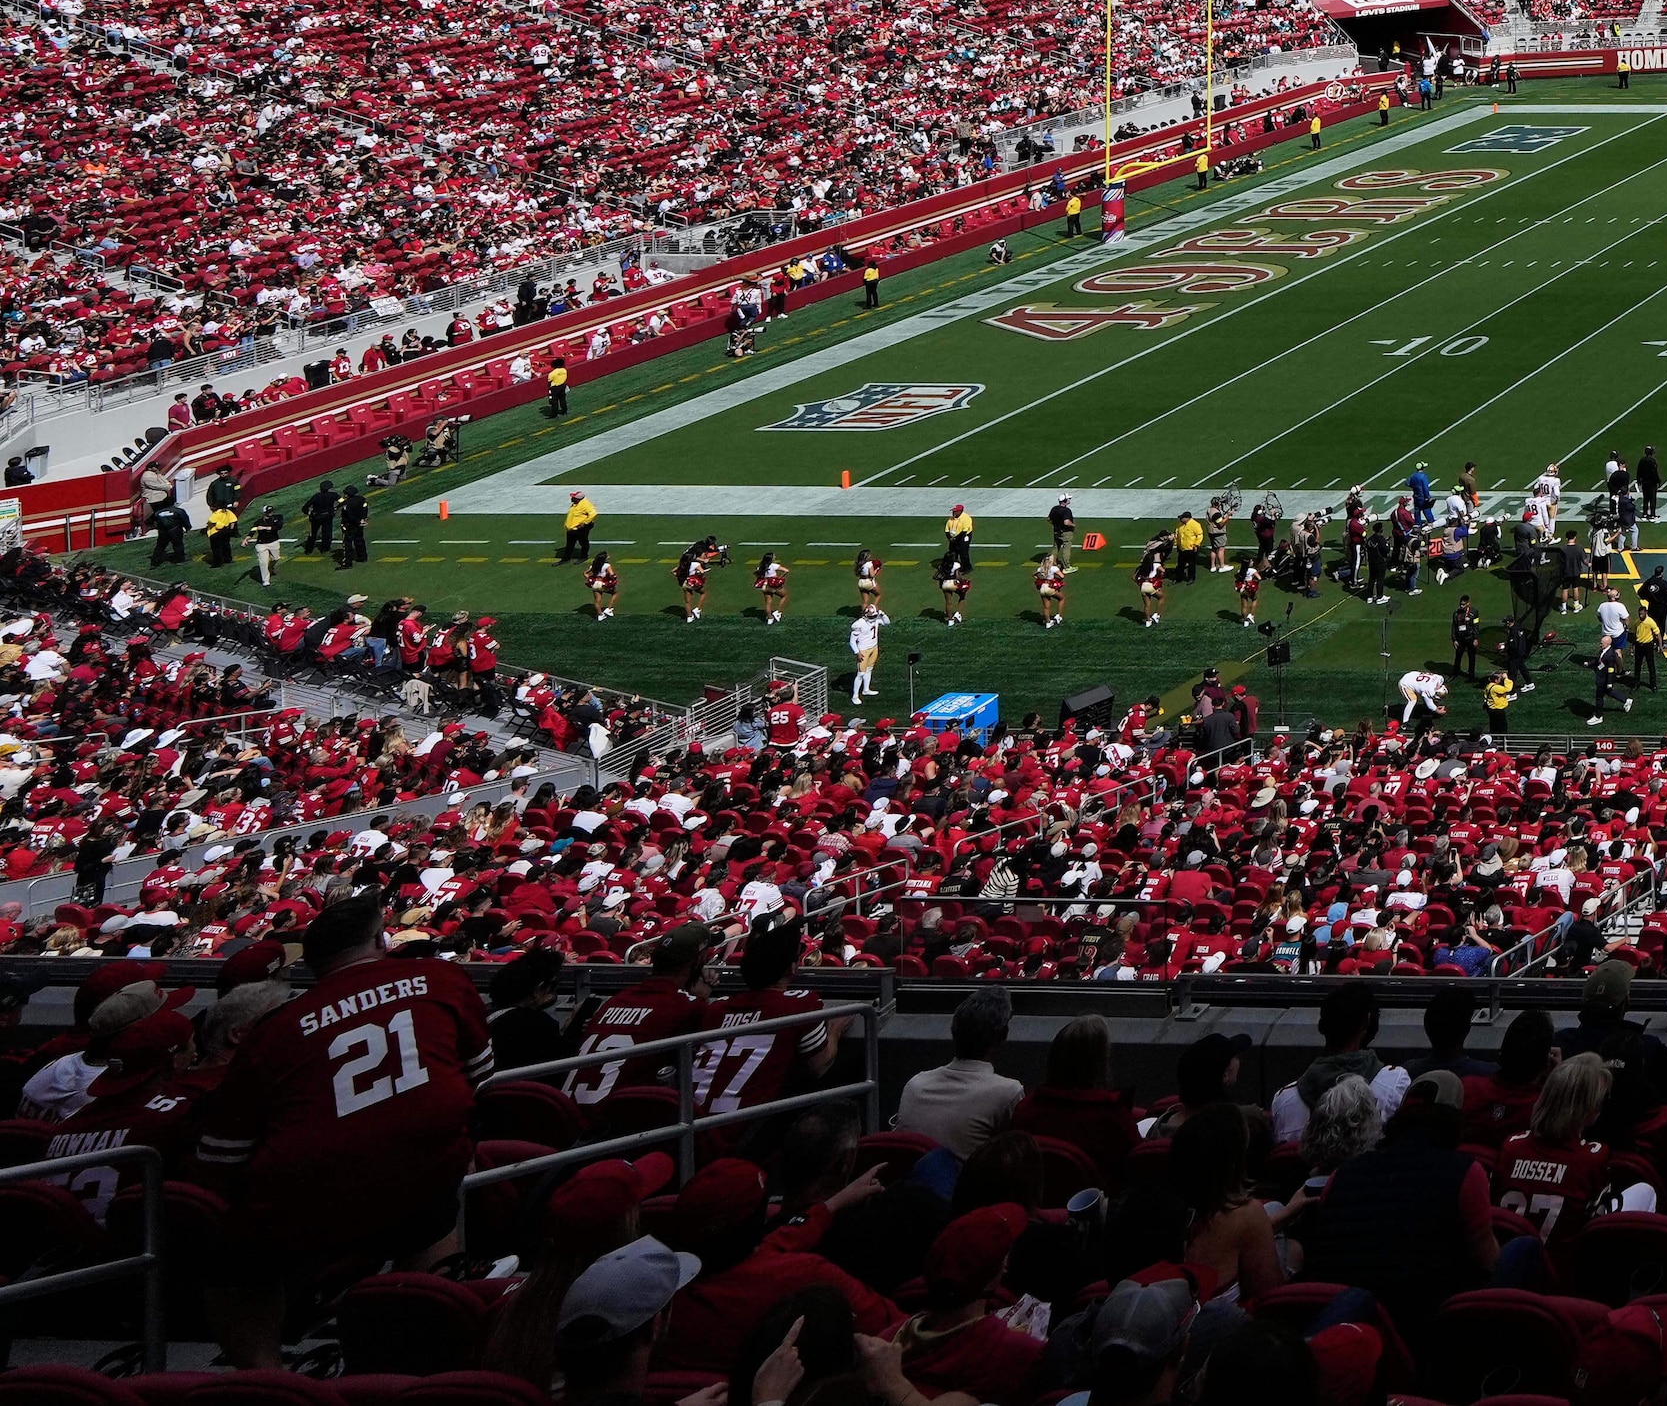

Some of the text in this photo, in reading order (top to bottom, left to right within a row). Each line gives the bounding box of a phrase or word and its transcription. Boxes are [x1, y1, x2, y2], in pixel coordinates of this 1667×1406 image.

[1386, 3, 1420, 14] STADIUM
[980, 169, 1510, 342] 49ERS
[982, 248, 1129, 296] TAKES
[1130, 217, 1211, 242] ALL
[1206, 196, 1252, 214] OF
[1382, 335, 1489, 356] 10
[848, 388, 963, 427] NFL
[299, 975, 429, 1038] SANDERS
[598, 1006, 654, 1026] PURDY
[720, 1009, 762, 1030] BOSA
[327, 1008, 430, 1119] 21
[560, 1033, 635, 1106] 13
[47, 1127, 131, 1159] BOWMAN
[1510, 1157, 1568, 1185] BOSSEN
